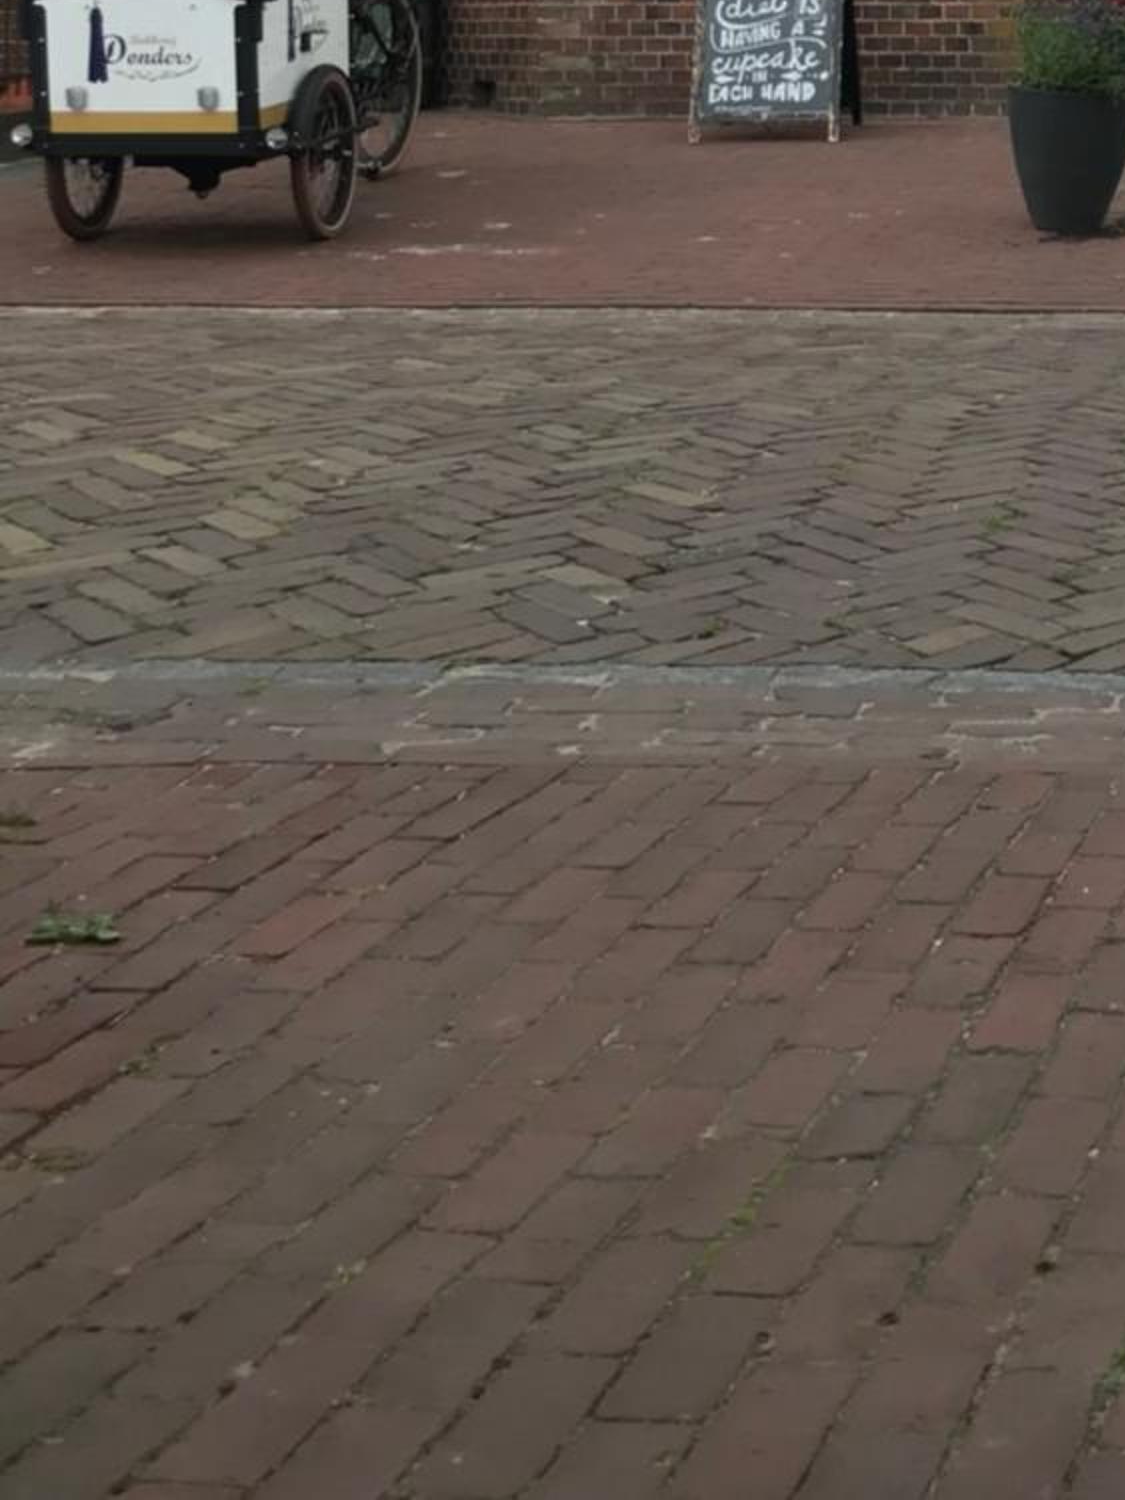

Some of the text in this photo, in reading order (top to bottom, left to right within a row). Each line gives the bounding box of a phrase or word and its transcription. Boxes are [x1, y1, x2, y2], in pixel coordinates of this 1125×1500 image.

[102, 34, 193, 66] Donders
[719, 21, 805, 49] HAVING A
[710, 39, 820, 83] cupcake
[707, 81, 817, 104] EACH HAND
